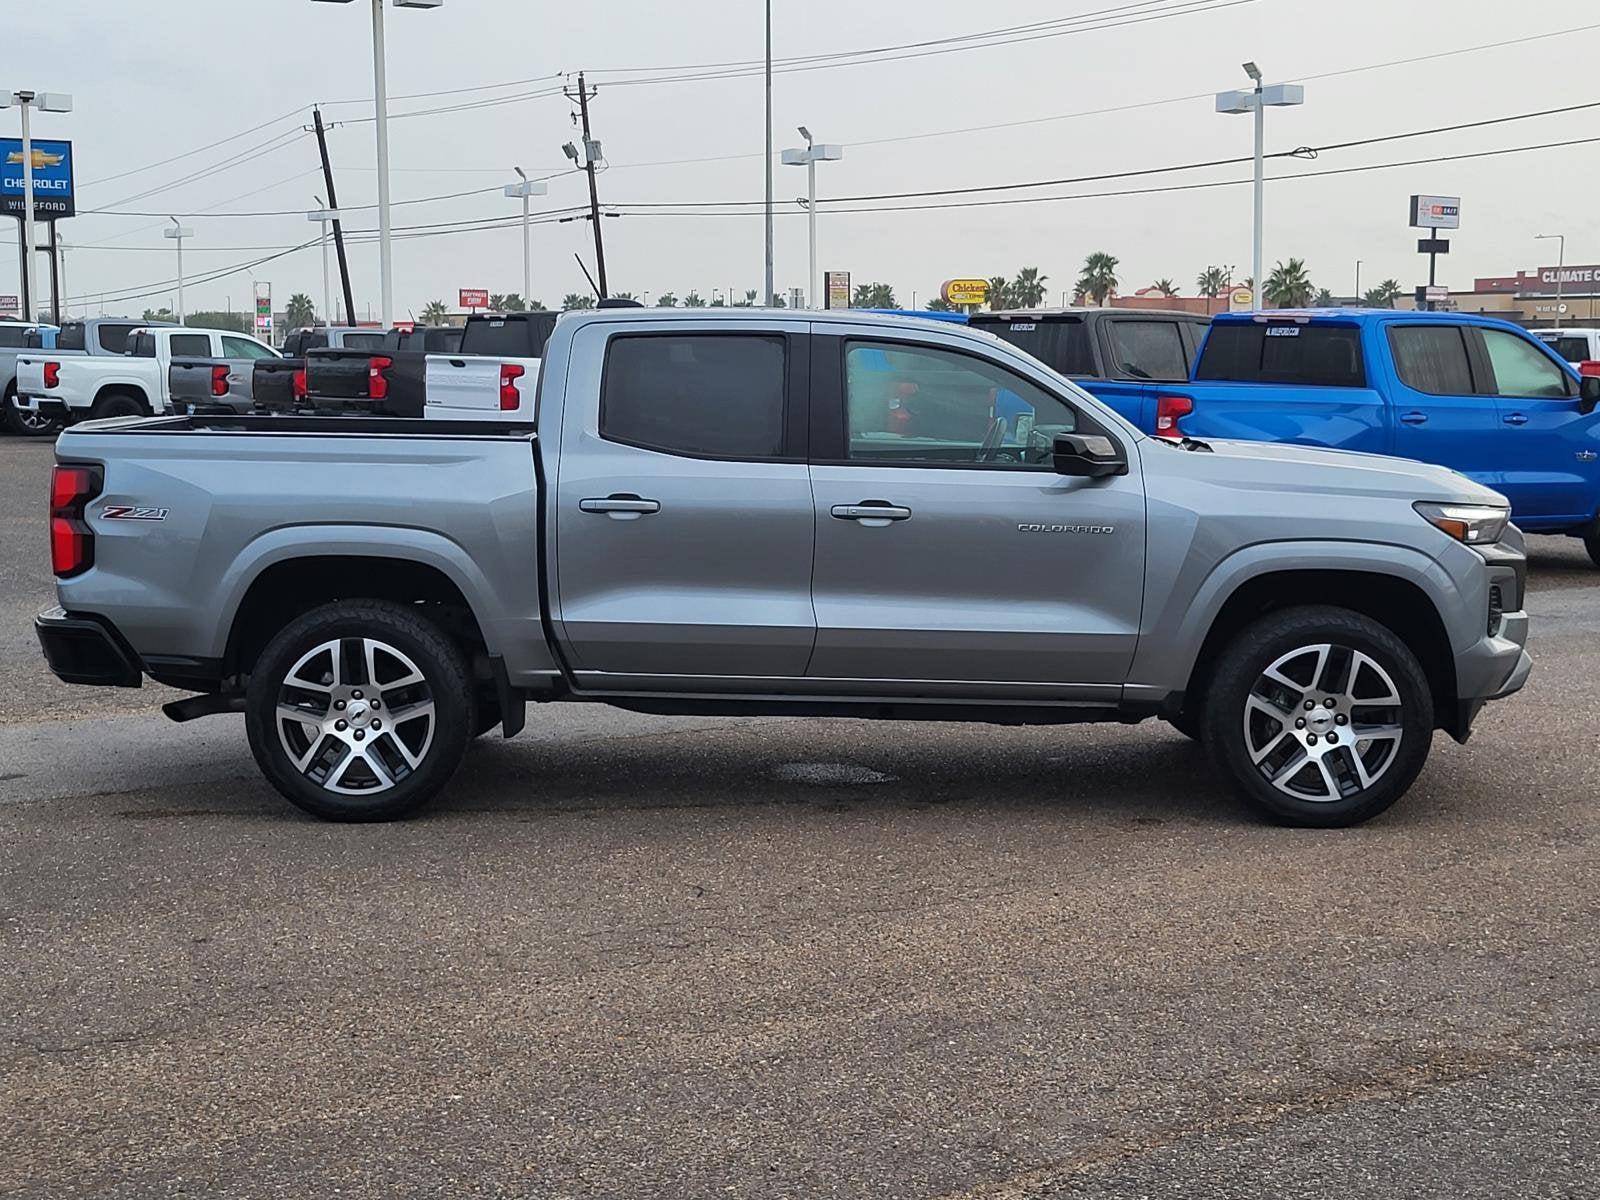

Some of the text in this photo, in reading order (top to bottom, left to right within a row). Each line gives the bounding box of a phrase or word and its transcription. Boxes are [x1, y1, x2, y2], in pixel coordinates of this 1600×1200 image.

[4, 178, 68, 189] CHEROLET
[8, 200, 66, 211] WILEFORD
[1542, 270, 1592, 283] CLIMATE
[101, 505, 170, 521] Z71
[1018, 523, 1114, 534] COLORADO
